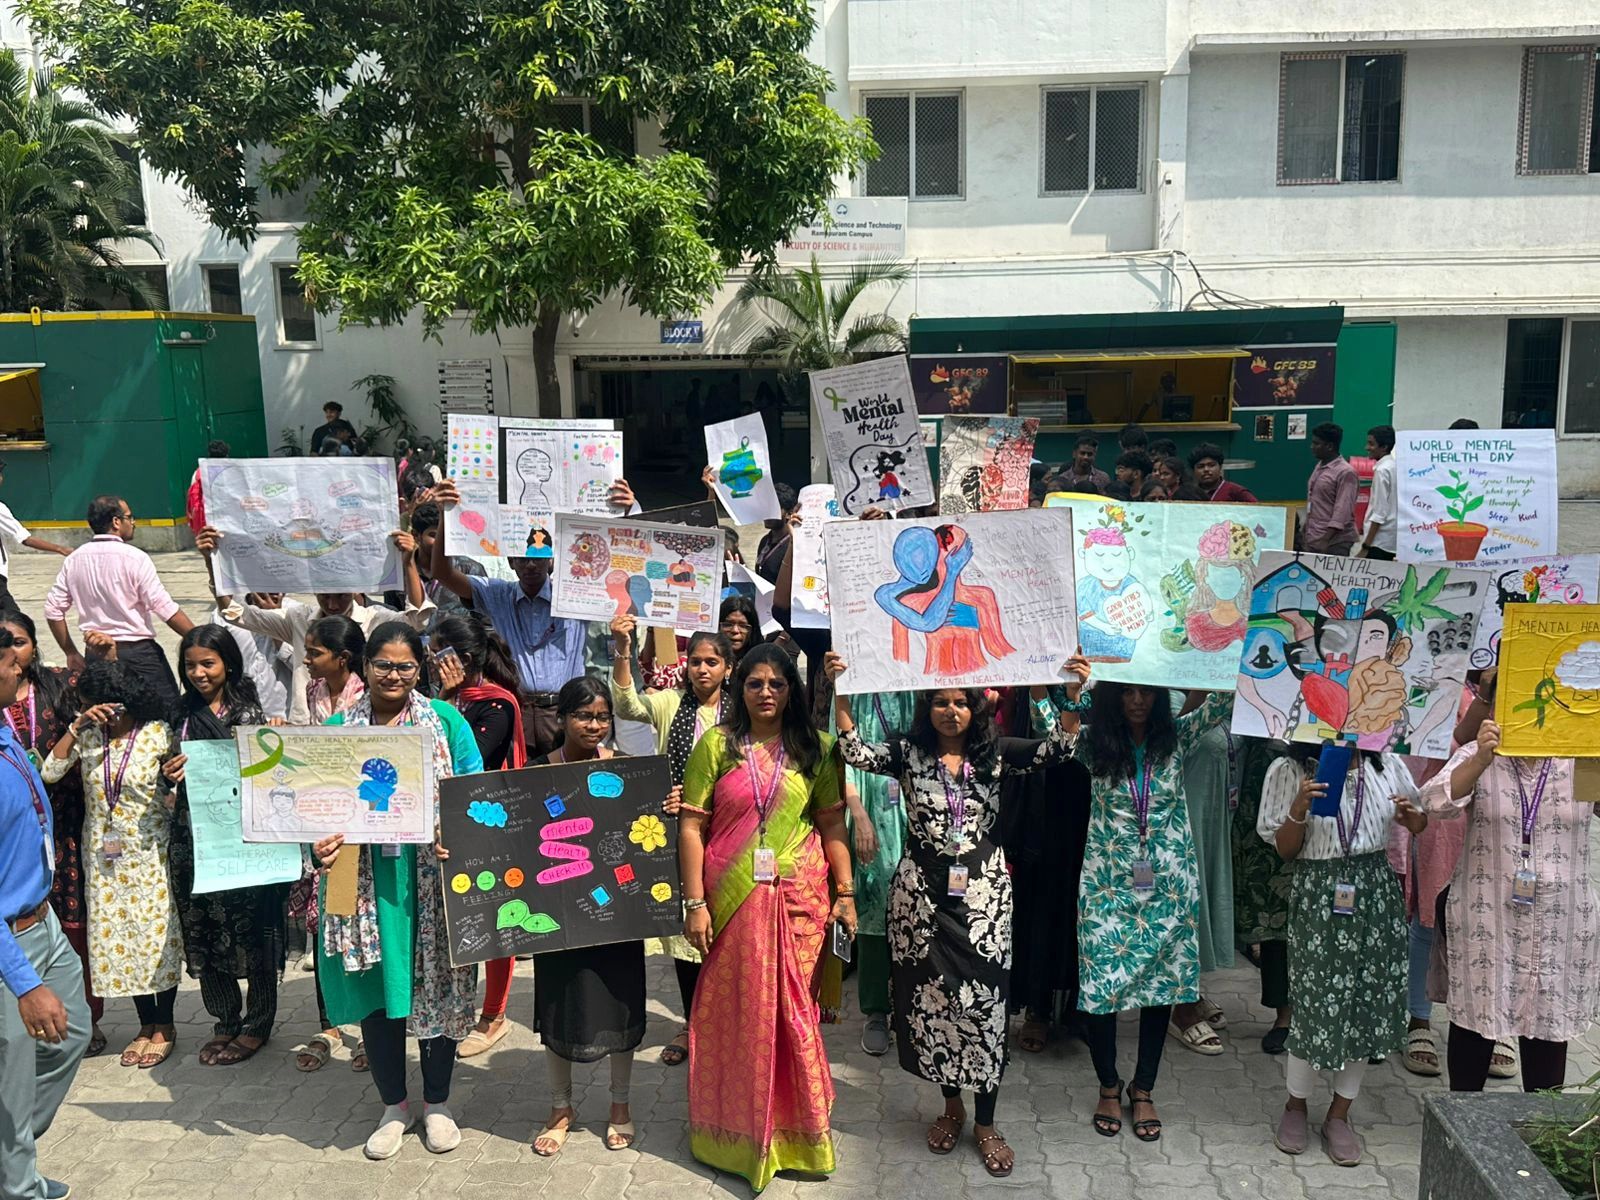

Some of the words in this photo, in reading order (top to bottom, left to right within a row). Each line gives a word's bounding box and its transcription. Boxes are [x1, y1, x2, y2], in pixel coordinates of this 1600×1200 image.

[868, 221, 902, 231] Technology
[811, 230, 848, 238] Rampuram
[812, 242, 822, 250] OF
[823, 242, 851, 251] SCIENCE
[663, 327, 693, 338] BLOCK
[1273, 360, 1297, 371] GFC
[858, 393, 891, 408] World
[841, 398, 905, 425] Mental
[857, 416, 900, 436] Health
[873, 430, 895, 444] Day
[1409, 440, 1454, 451] WORLD
[1465, 439, 1517, 451] MENTAL
[1430, 452, 1479, 463] HEALTH
[1489, 452, 1515, 463] DAY
[1468, 468, 1488, 478] Hope
[1411, 495, 1433, 511] Care
[1488, 510, 1509, 523] Sleep
[1518, 509, 1538, 522] Kind
[1414, 543, 1434, 556] Love
[1313, 555, 1378, 575] MENTAL
[999, 566, 1044, 580] MENTAL
[1331, 573, 1377, 589] HEALTH
[1376, 576, 1404, 591] DAY
[1518, 620, 1573, 634] MENTAL
[1580, 620, 1600, 633] HEA
[1025, 653, 1057, 665] ALONE
[934, 677, 970, 688] MENTAL
[972, 675, 1005, 685] HEALTH
[287, 736, 320, 744] MENTAL
[324, 736, 352, 744] HEALTH
[356, 736, 400, 744] AWARENESS
[465, 857, 484, 869] HOW
